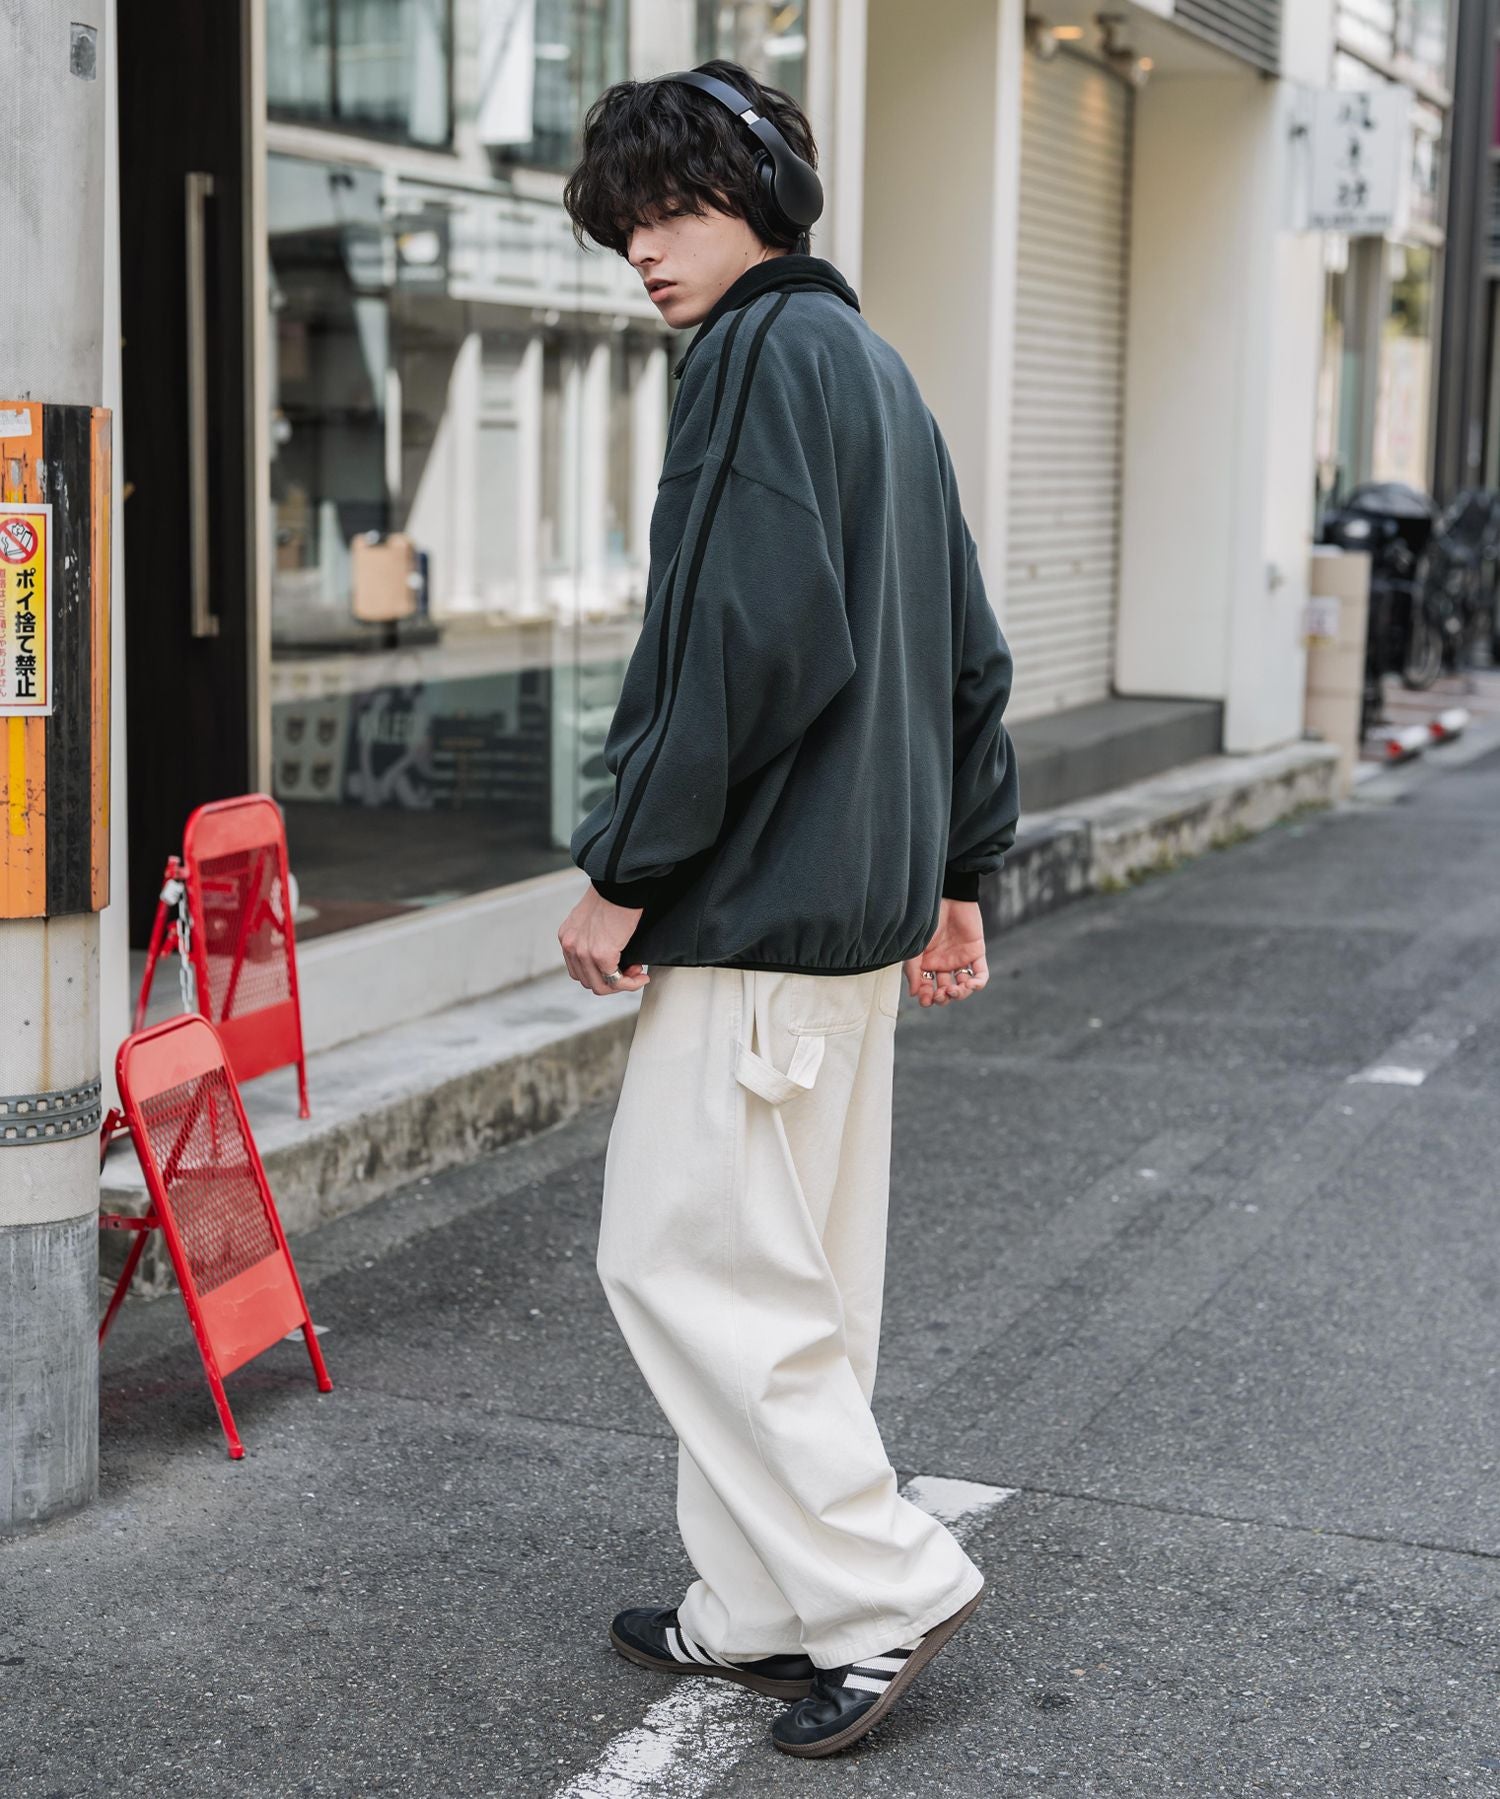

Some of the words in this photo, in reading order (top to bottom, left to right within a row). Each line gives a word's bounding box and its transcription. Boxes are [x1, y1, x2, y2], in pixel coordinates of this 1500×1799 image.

[15, 567, 36, 697] ポイ捨て禁止
